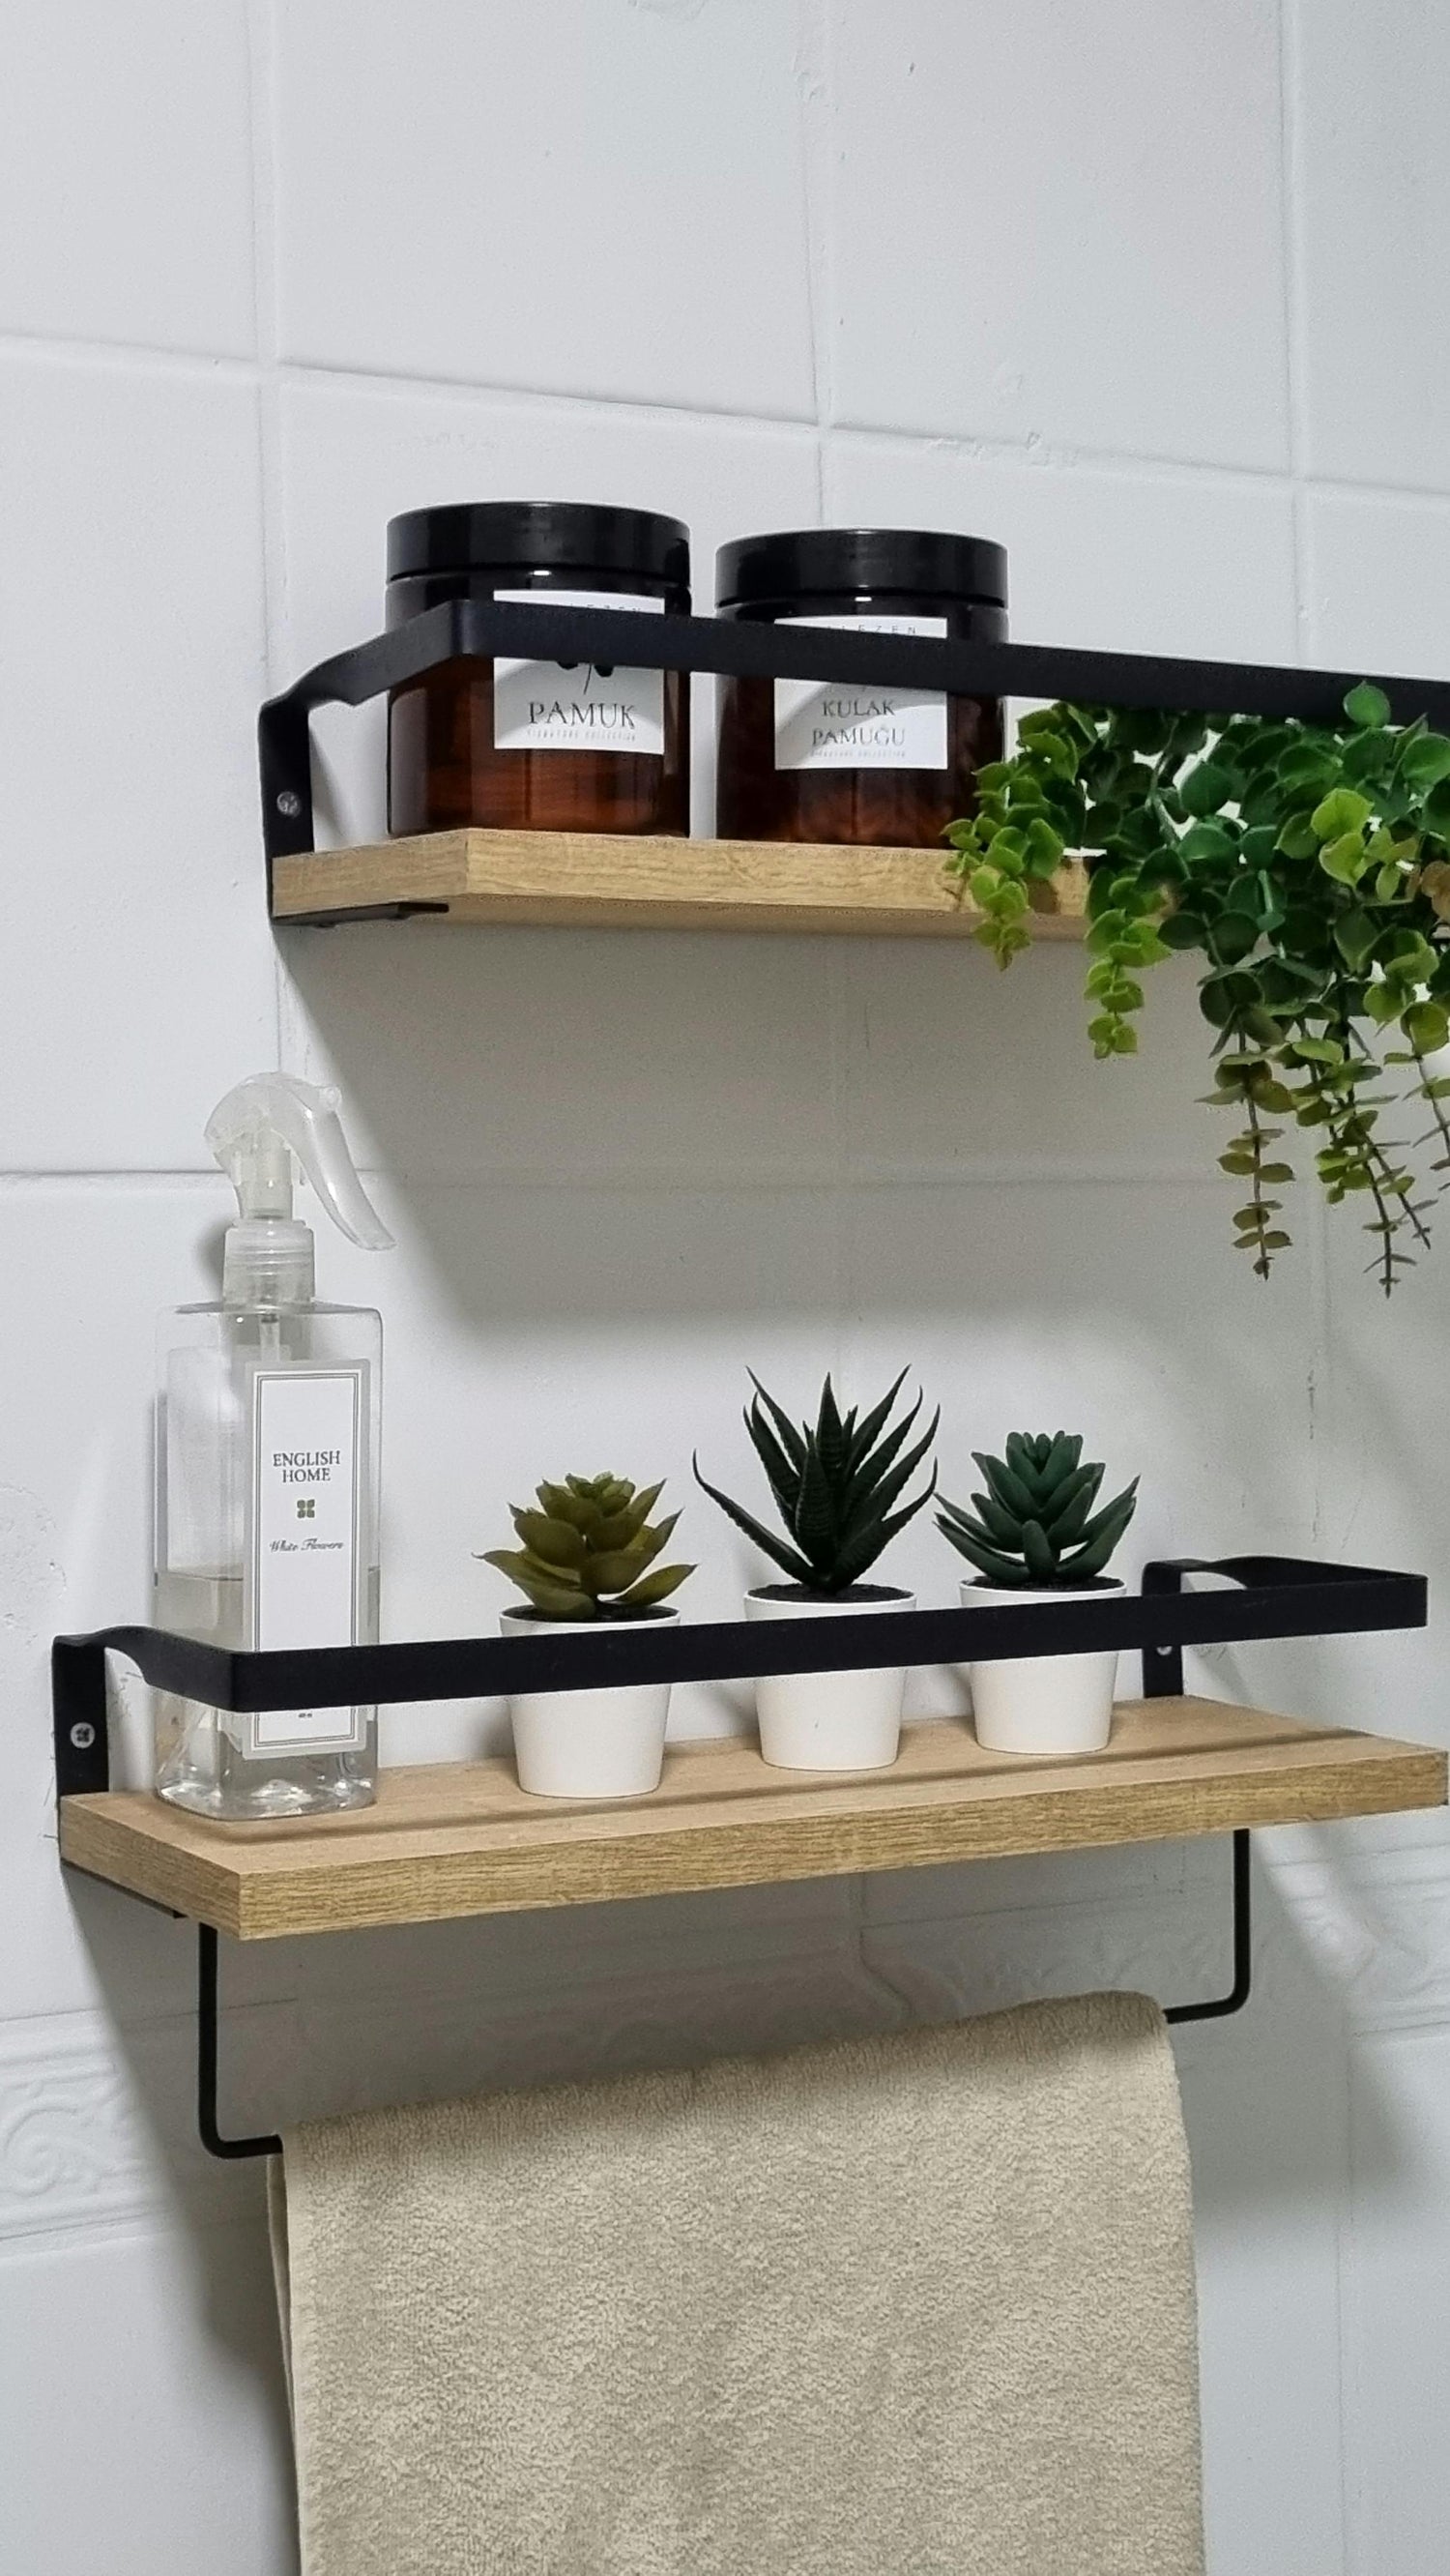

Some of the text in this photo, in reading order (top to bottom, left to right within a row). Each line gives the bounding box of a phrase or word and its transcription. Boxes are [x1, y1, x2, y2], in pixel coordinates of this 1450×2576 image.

[528, 701, 635, 729] PAMUK
[822, 699, 895, 717] KULAK
[812, 724, 906, 746] PAMUĞU
[273, 1450, 340, 1467] ENGLISH
[282, 1468, 332, 1483] HOME
